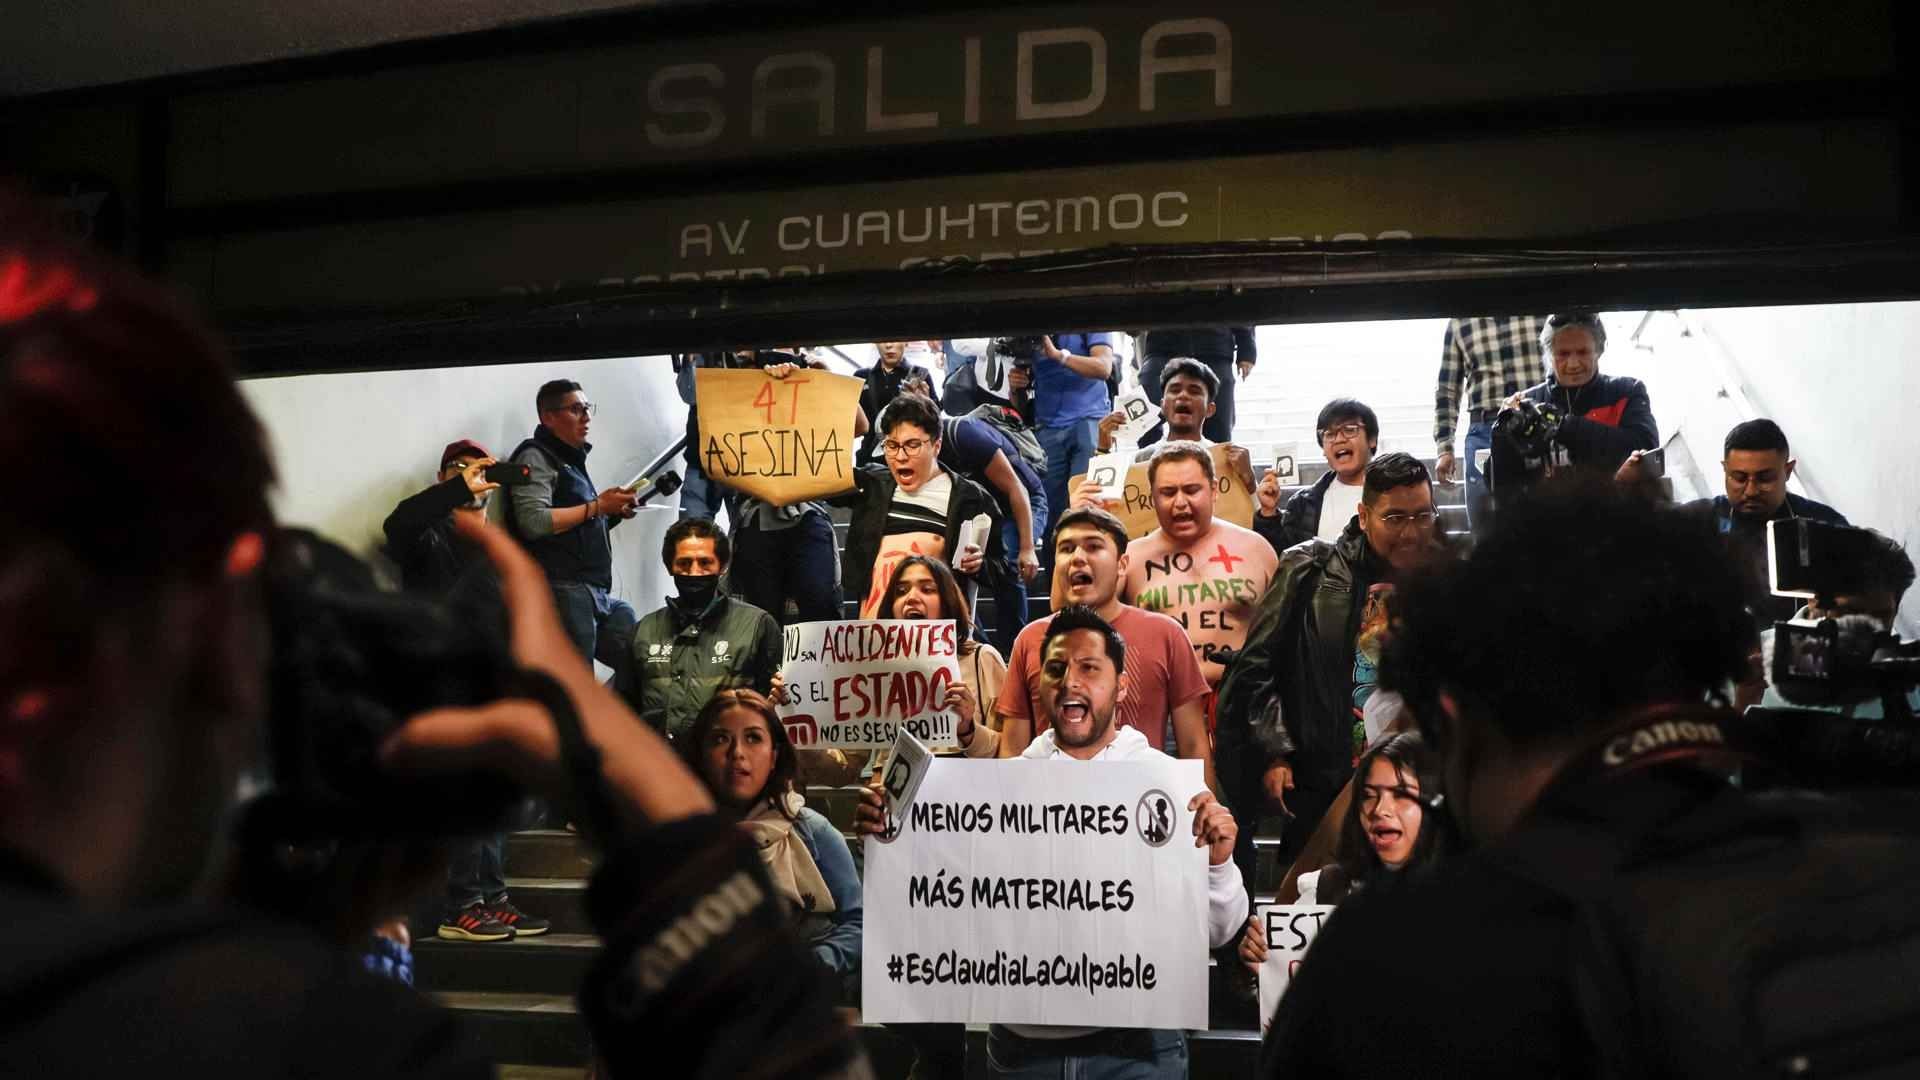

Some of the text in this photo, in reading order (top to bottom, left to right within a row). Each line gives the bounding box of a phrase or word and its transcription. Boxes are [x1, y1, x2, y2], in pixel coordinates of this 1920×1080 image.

[643, 17, 1233, 148] SALIDA
[680, 191, 1189, 259] AV. CUAUHTEMOC
[753, 377, 810, 425] 4T
[705, 428, 844, 478] ASESINA
[1145, 552, 1193, 581] NO
[1136, 578, 1257, 609] MILITARES
[1200, 610, 1233, 630] EL
[785, 626, 800, 662] NO
[821, 623, 955, 664] ACCIDENTES
[811, 681, 829, 702] EL
[833, 666, 953, 722] ESTADO
[820, 724, 840, 744] NO
[845, 725, 860, 744] ES
[1602, 720, 1724, 766] Canon
[911, 802, 1129, 835] MENOS MILITARES
[909, 869, 1135, 912] MÁS MATERIALES
[887, 950, 1157, 996] #EsClaudiaLaCulpable
